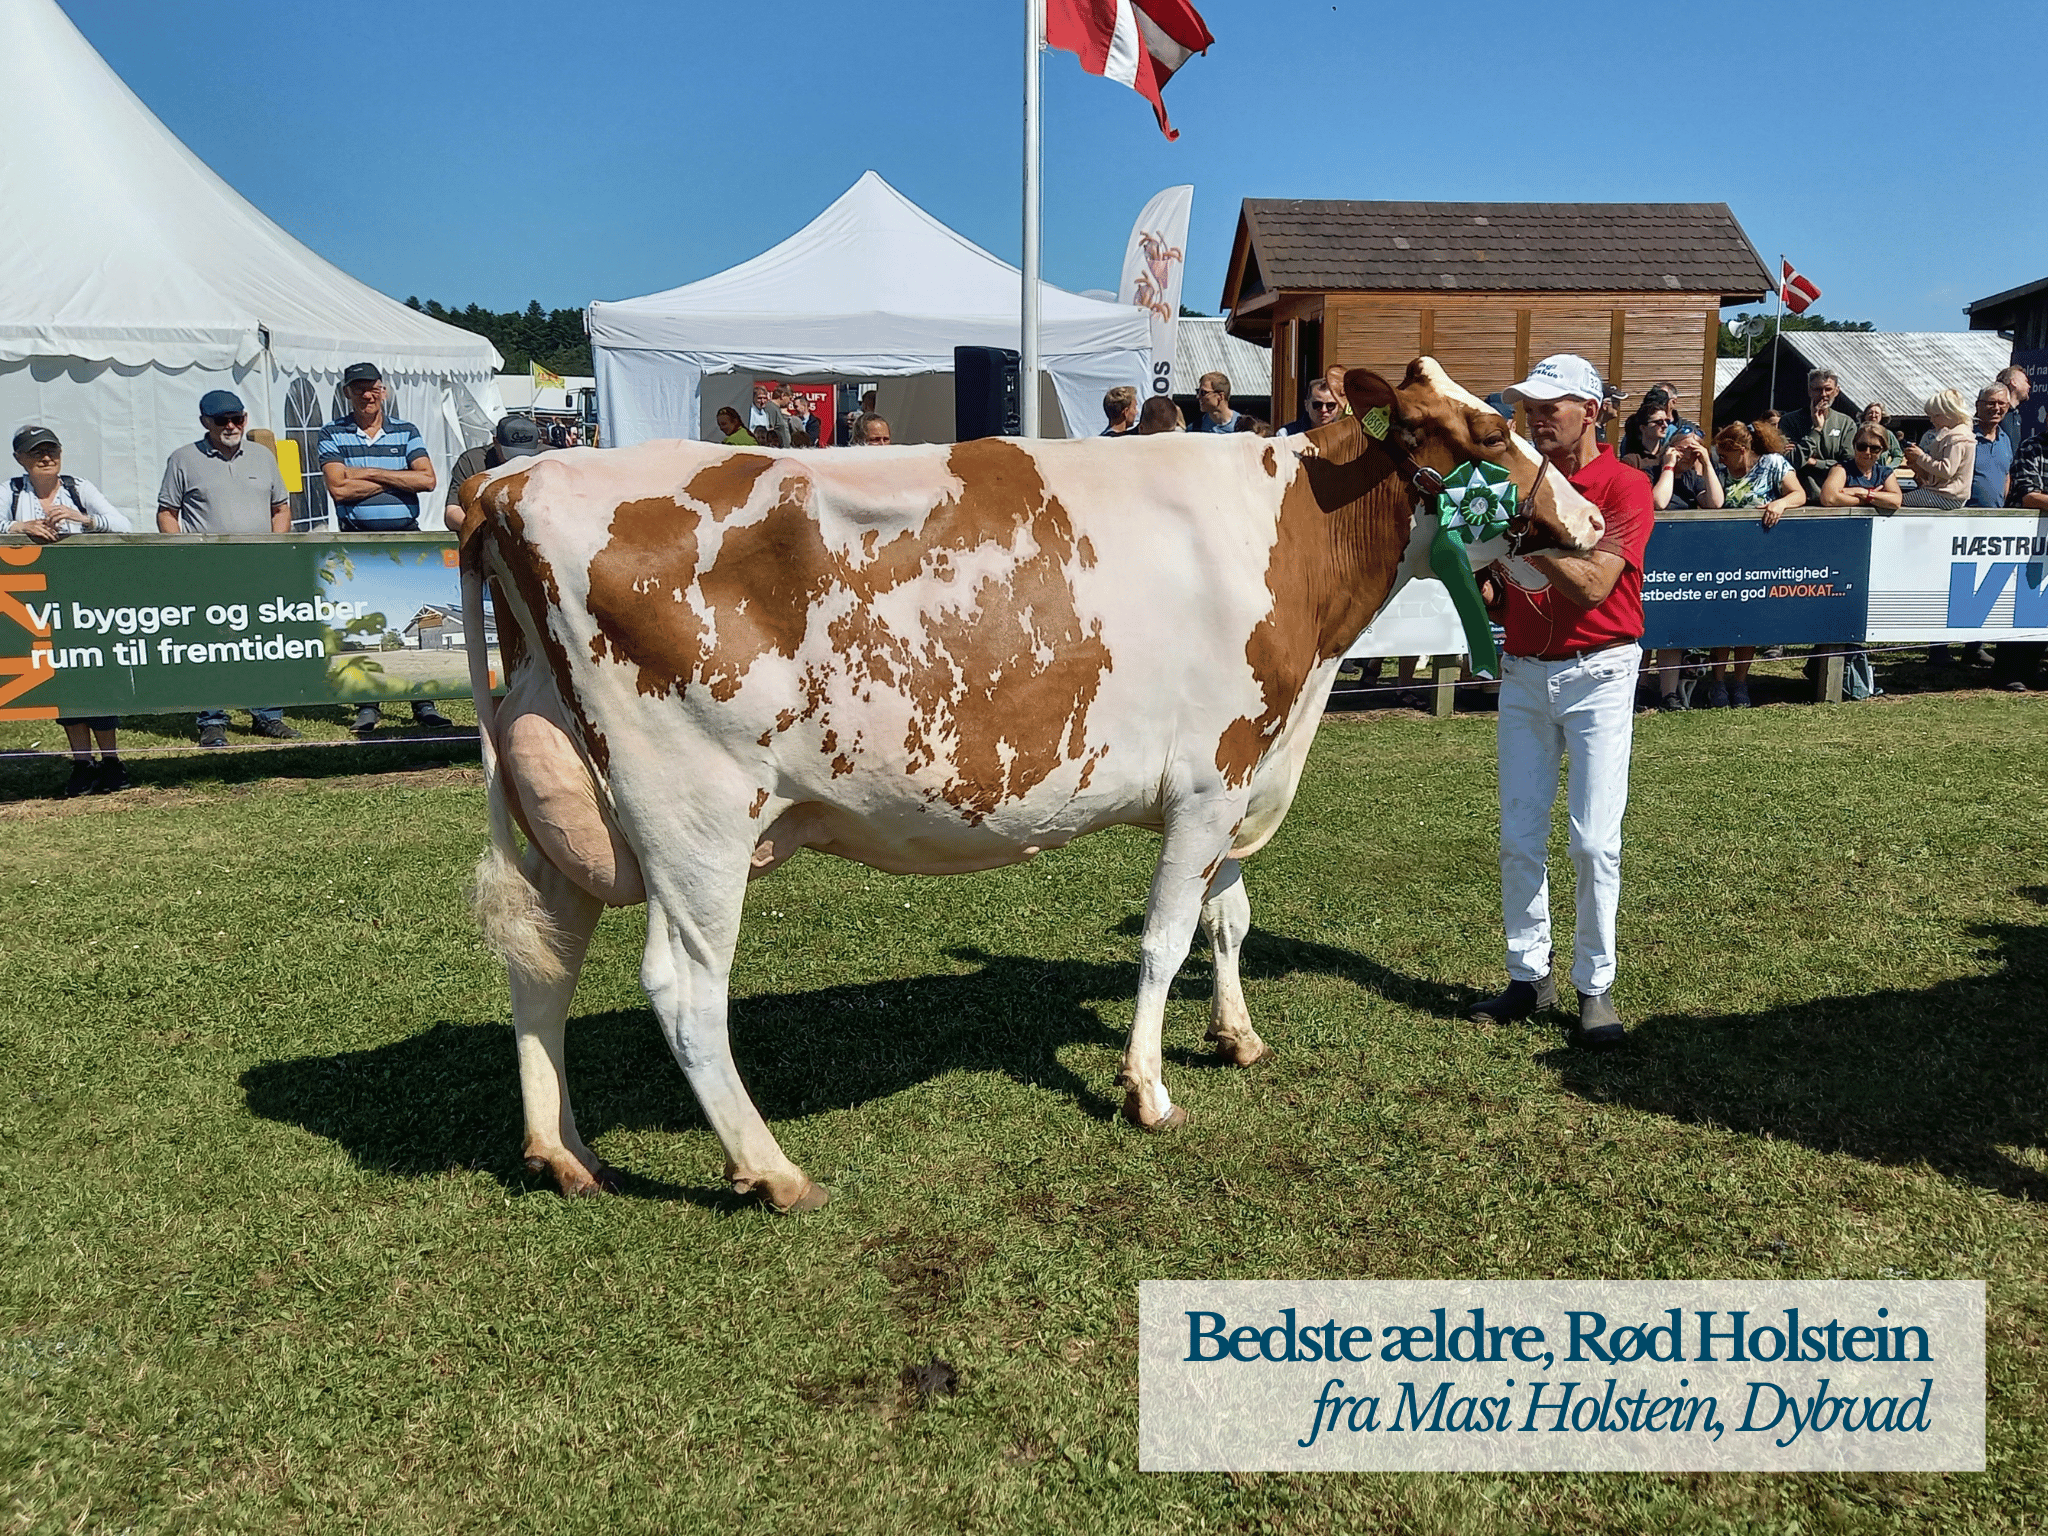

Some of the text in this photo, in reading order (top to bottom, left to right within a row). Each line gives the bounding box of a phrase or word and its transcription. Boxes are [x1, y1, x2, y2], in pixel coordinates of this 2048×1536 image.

[1152, 361, 1170, 394] OS
[1363, 411, 1386, 436] 08501
[1951, 536, 2048, 556] HÆSTRU
[1679, 572, 1693, 582] er
[1696, 571, 1713, 581] en
[1716, 568, 1742, 584] god
[1745, 566, 1829, 582] samvittighed
[1705, 590, 1718, 600] er
[1721, 589, 1738, 599] en
[1740, 585, 1766, 602] god
[25, 595, 368, 635] Vi bygger og skaber
[31, 633, 325, 669] rum til fremtiden
